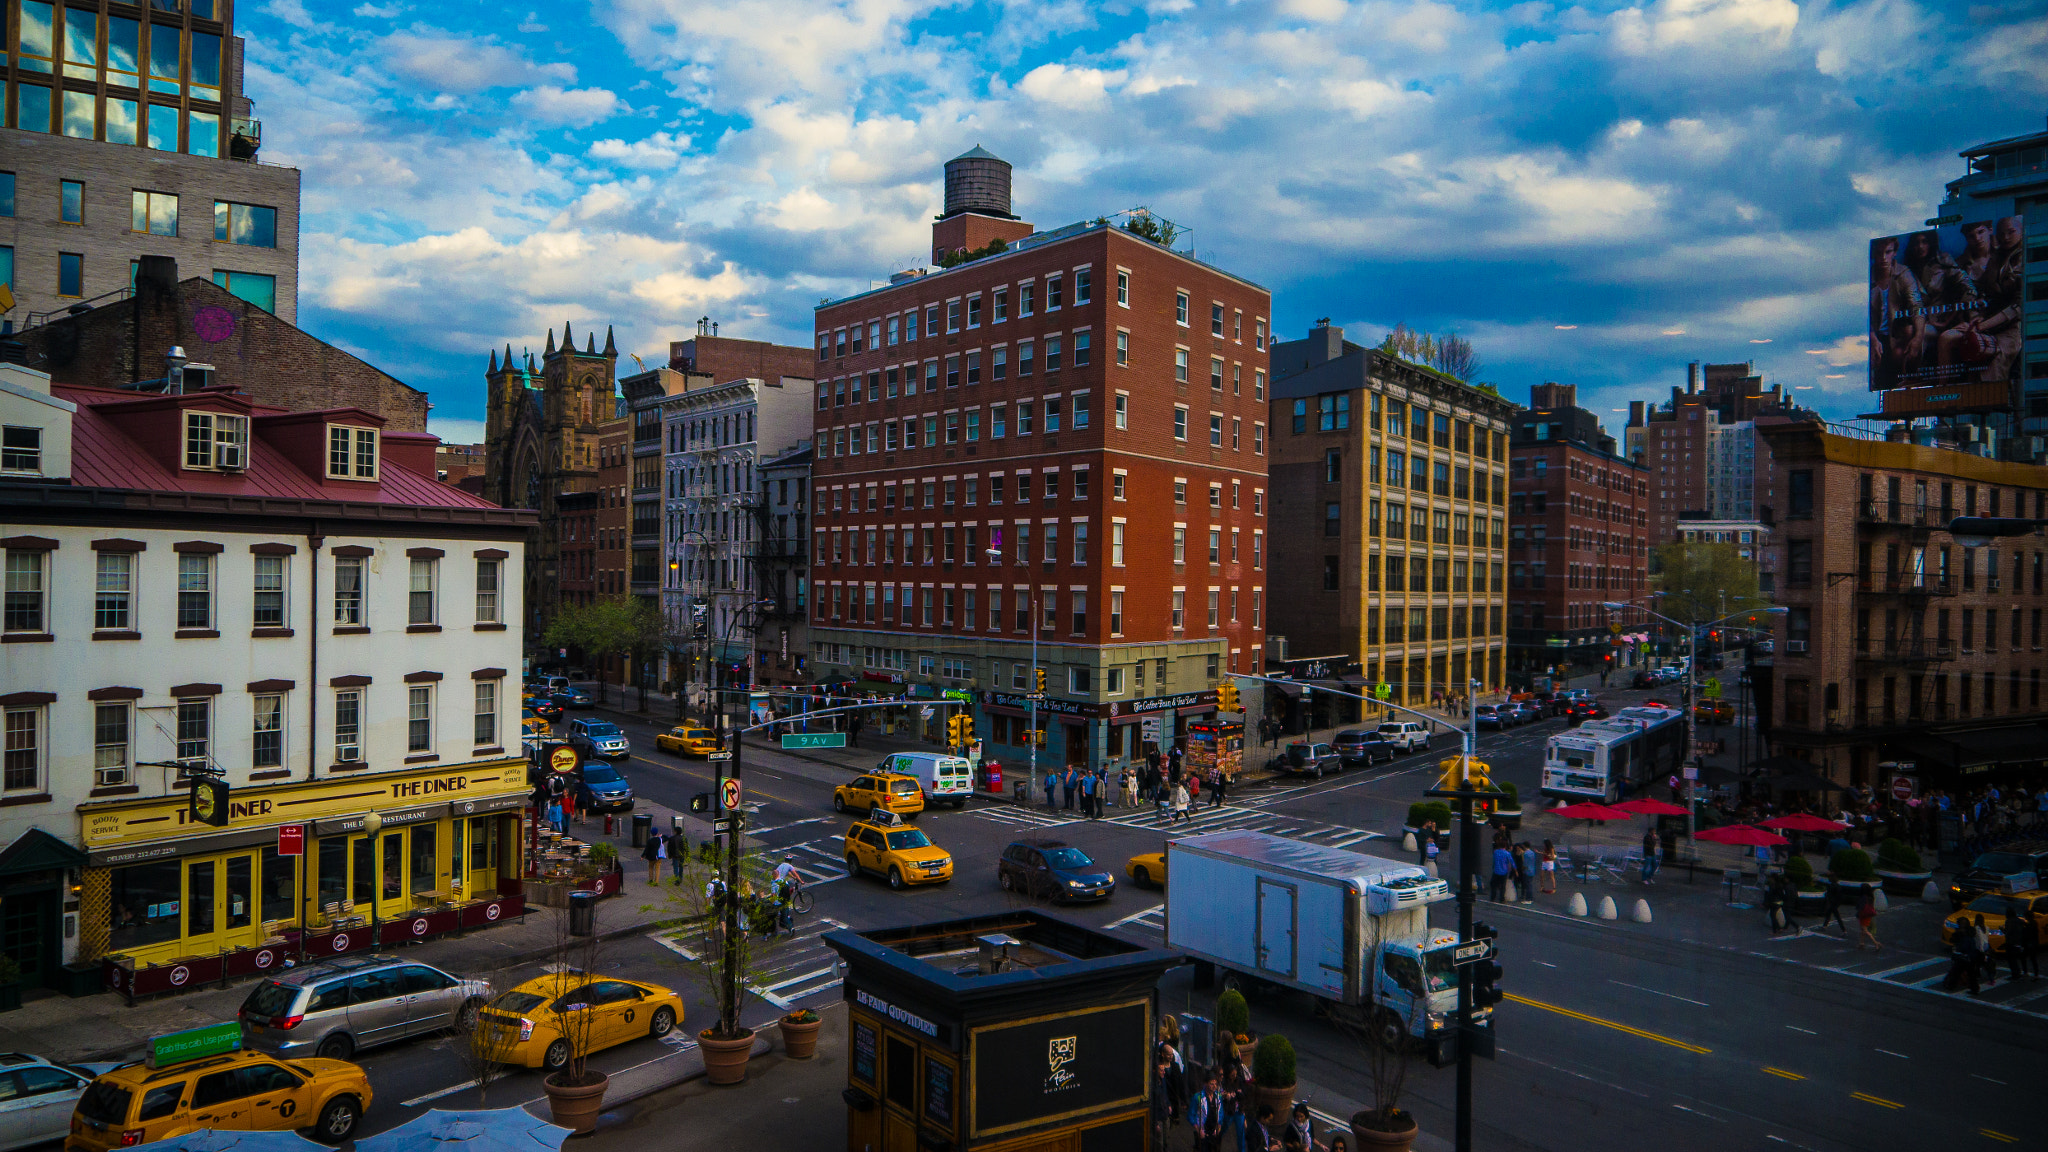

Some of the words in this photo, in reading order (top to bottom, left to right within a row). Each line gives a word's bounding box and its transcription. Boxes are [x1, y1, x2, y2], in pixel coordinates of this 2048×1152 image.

[1894, 299, 1989, 319] BURBERRY
[945, 690, 971, 703] pinkberry
[1049, 700, 1061, 710] Tea
[1133, 701, 1143, 712] The
[1143, 699, 1159, 710] Coffee
[1159, 698, 1171, 708] Bean
[1171, 697, 1177, 705] &
[801, 737, 807, 745] 9
[811, 737, 827, 745] Av
[391, 781, 421, 798] THE
[423, 776, 467, 795] DINER
[229, 799, 272, 819] INER
[93, 816, 119, 825] BOOTH
[382, 811, 426, 824] RESTAURANT
[91, 826, 119, 836] SERVICE
[342, 821, 357, 829] THE
[106, 852, 136, 863] DELIVERY
[1459, 949, 1470, 957] ONE
[856, 989, 868, 1005] LE
[868, 994, 889, 1014] PAIN
[888, 1003, 938, 1038] QUOTIDIEN
[155, 1045, 174, 1055] Grab
[174, 1042, 187, 1050] this
[203, 1036, 217, 1045] Use
[1049, 1069, 1075, 1087] Pain
[1043, 1083, 1081, 1095] QUOTIDIEN
